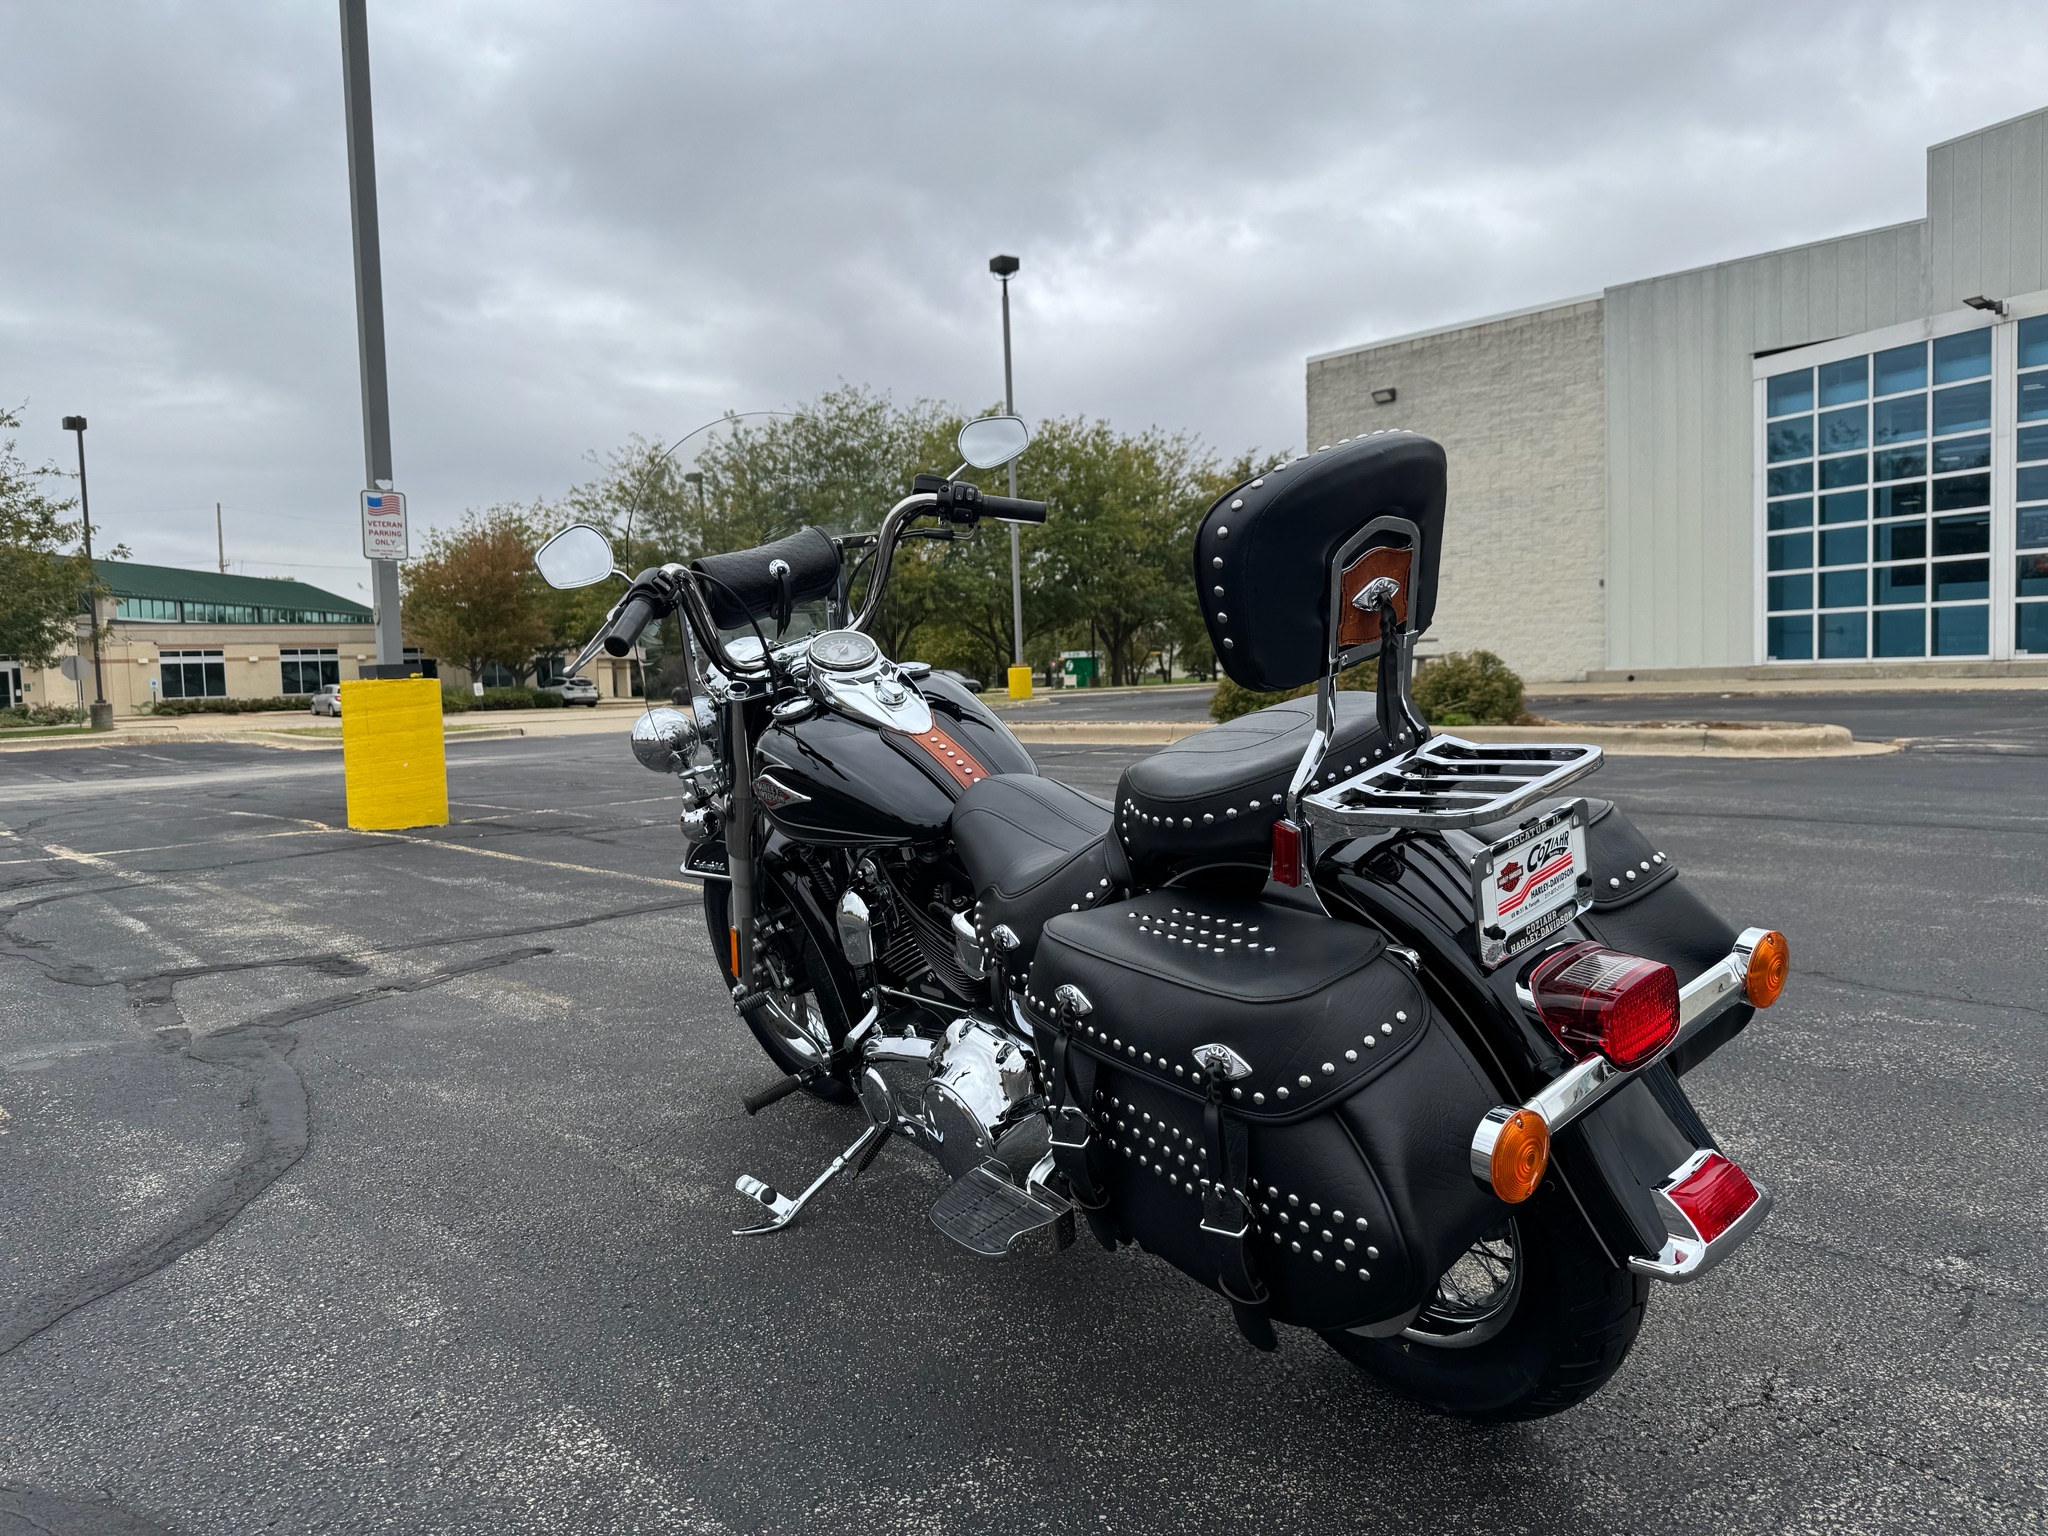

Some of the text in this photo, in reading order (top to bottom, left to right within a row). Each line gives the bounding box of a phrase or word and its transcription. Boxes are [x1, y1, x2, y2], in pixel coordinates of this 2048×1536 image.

[368, 520, 402, 528] VETERAN
[368, 529, 402, 537] PARKING
[375, 538, 396, 546] ONLY
[1552, 815, 1561, 826] IL
[1527, 830, 1570, 873] COZIAHR
[1530, 866, 1574, 899] HARLEY-DAVIDSON
[1510, 909, 1573, 953] HARLEY-DAVIDSON
[1526, 910, 1557, 935] COZIAHR
